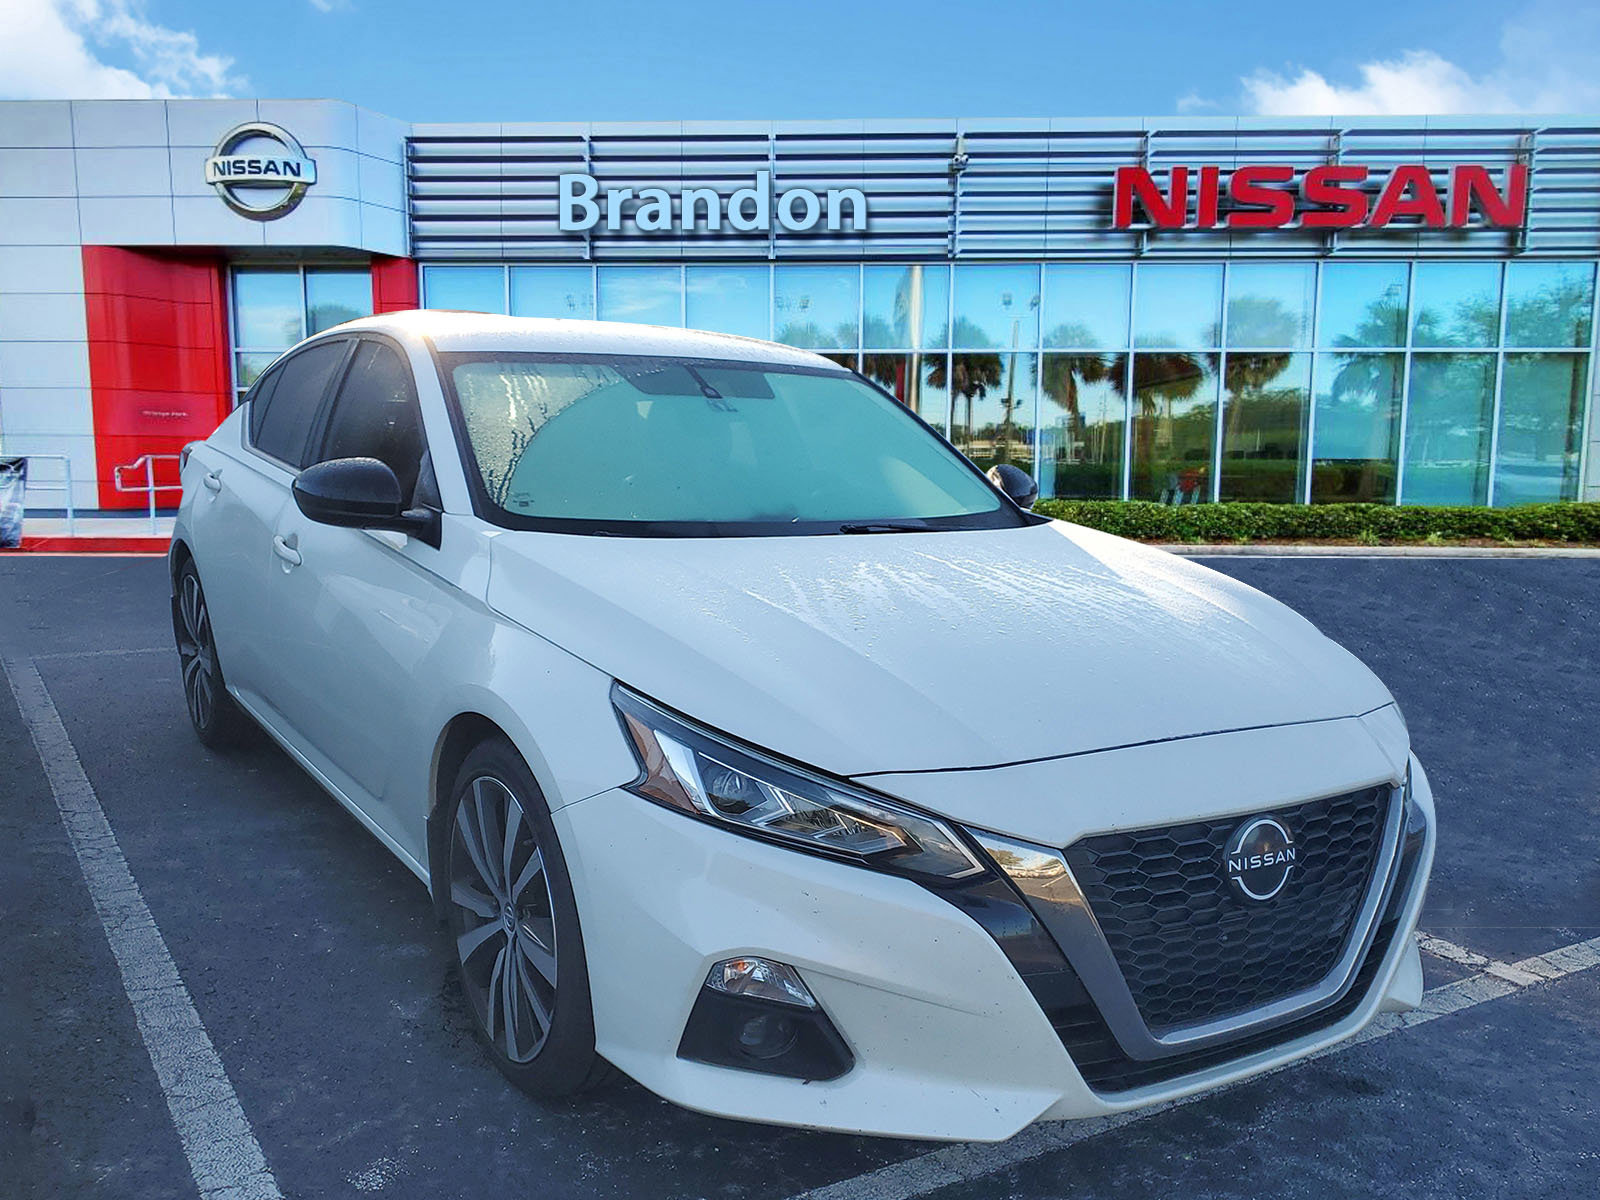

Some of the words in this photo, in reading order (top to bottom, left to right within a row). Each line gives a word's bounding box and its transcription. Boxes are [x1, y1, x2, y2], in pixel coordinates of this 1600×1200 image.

[213, 159, 301, 177] NISSAN
[559, 170, 867, 231] Brandon
[1113, 165, 1528, 228] NISSAN
[1228, 847, 1296, 873] NISSAN
